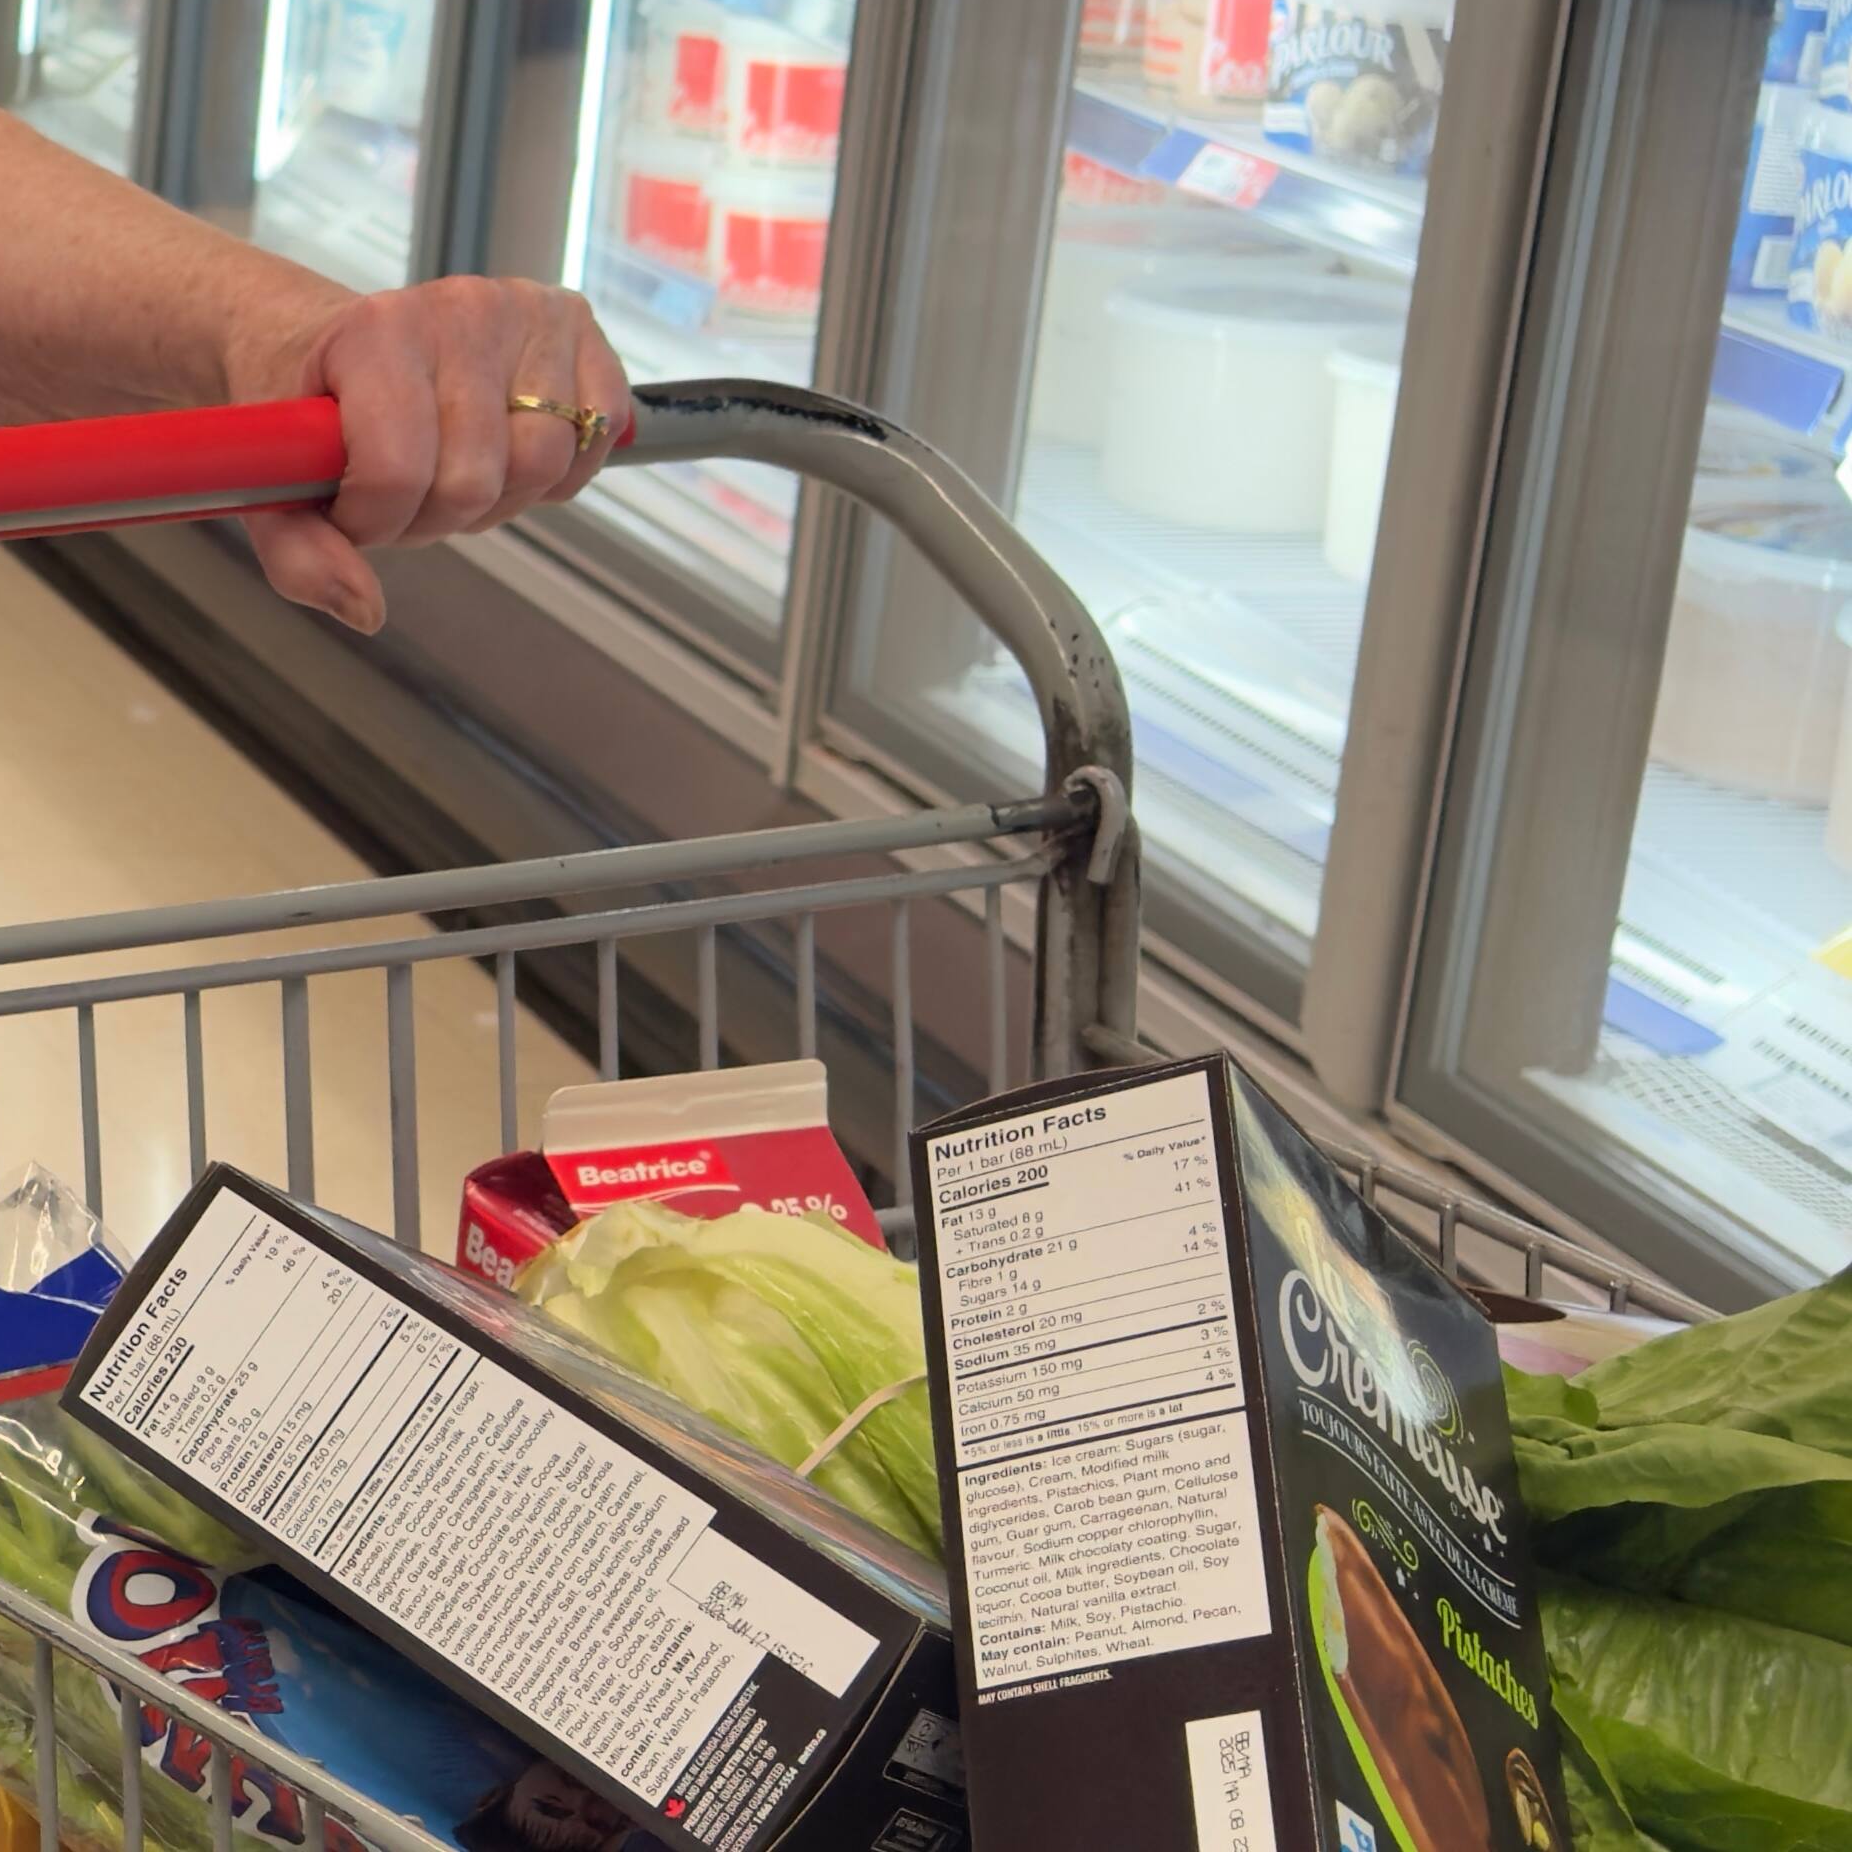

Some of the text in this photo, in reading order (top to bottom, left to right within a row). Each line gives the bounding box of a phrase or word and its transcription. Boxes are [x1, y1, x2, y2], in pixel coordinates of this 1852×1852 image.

[933, 1105, 1108, 1163] Nutrition Facts
[577, 1154, 708, 1187] Beatrice
[935, 1134, 1069, 1182] Per 1 bar (88 mL)
[937, 1163, 1050, 1206] Calories 200
[940, 1206, 998, 1230] Fat 13 g
[952, 1210, 1045, 1243] Saturated 8 g
[944, 1238, 1079, 1281] Carbohydrate 21 g
[958, 1278, 1043, 1309] Sugars 14 g
[87, 1266, 189, 1404] Nutrition Facts
[949, 1302, 1029, 1331] Protein 2 g
[951, 1310, 1084, 1352] Cholesterol 20 mg
[952, 1338, 1057, 1372] Sodium 35 mg
[122, 1335, 189, 1426] Calories 230
[955, 1357, 1084, 1397] Potassium 150 mg
[957, 1383, 1061, 1418] Calcium 50 mg
[180, 1386, 240, 1467] Carbohydrate
[422, 1415, 457, 1456] Sugars
[1124, 1432, 1175, 1453] Sugars
[218, 1449, 255, 1494] Protein
[233, 1434, 287, 1505] Cholesterol
[1079, 1454, 1140, 1478] Modified
[1141, 1448, 1171, 1465] milk
[1121, 1466, 1159, 1486] Plant
[1160, 1460, 1202, 1478] mono
[1203, 1451, 1232, 1470] and
[249, 1468, 288, 1516] Sodium
[1052, 1496, 1096, 1516] Carob
[1097, 1490, 1134, 1508] bean
[1173, 1468, 1240, 1492] Cellulose
[973, 1575, 1031, 1600] Coconut
[1054, 1564, 1084, 1581] Milk
[1168, 1535, 1241, 1560] Chocolate
[499, 1651, 535, 1695] Natural
[575, 1543, 613, 1588] Sodium
[979, 1647, 1010, 1665] May
[1436, 1597, 1539, 1731] Pistaches
